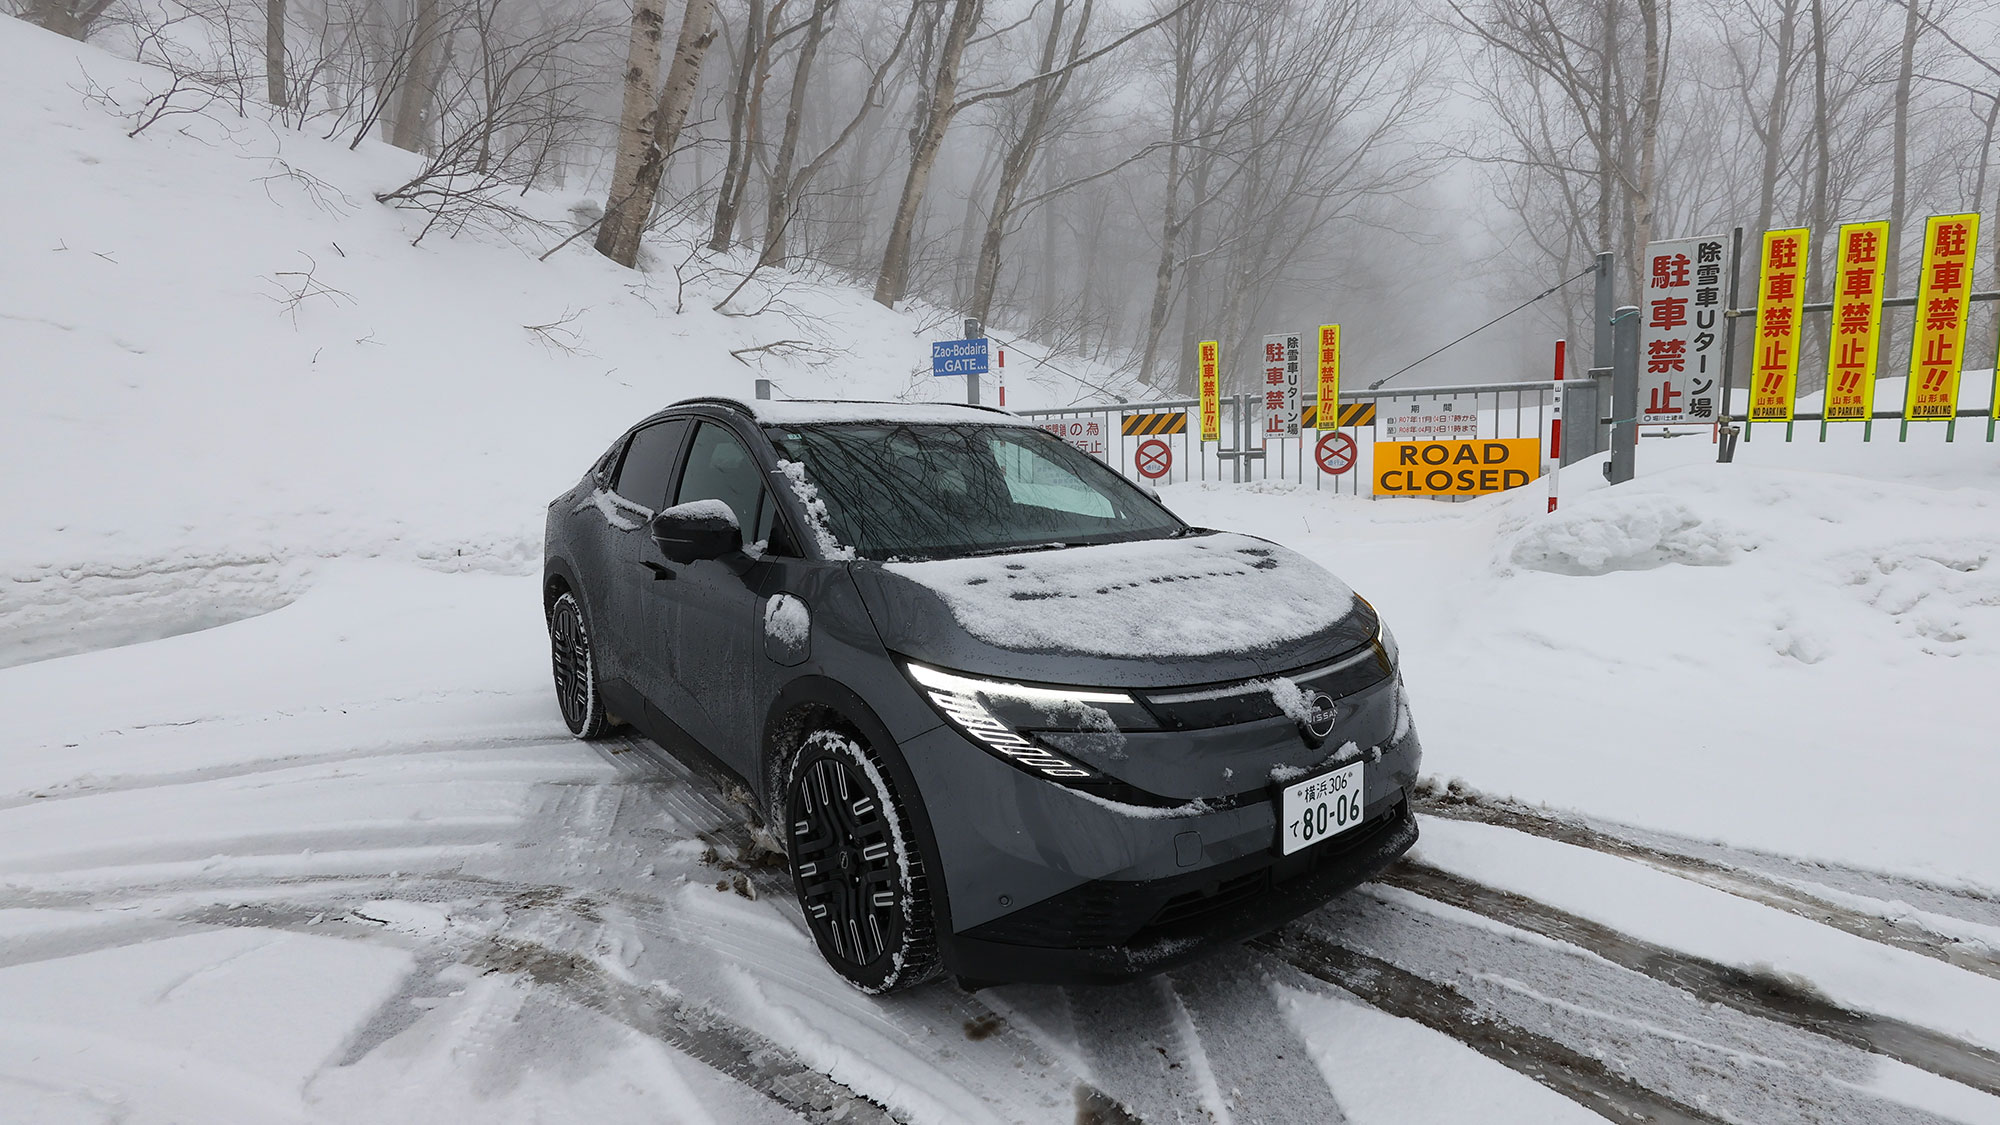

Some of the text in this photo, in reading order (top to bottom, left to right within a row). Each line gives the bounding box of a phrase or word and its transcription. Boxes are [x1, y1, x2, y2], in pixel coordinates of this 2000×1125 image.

[1644, 254, 1691, 414] 駐車禁止
[1689, 241, 1722, 418] 除雪車Uターン場
[934, 343, 987, 358] Zao-Bodaira
[944, 358, 977, 372] GATE
[1266, 343, 1285, 433] 駐車禁止
[1287, 337, 1299, 435] 除雪車Uターン場
[1757, 396, 1784, 405] 山形県
[1833, 396, 1861, 405] 山形県
[1918, 394, 1948, 403] 山形県
[1752, 407, 1787, 416] NO PARKING
[1828, 406, 1864, 416] NO PARKING
[1913, 405, 1951, 415] NO PARKING
[1400, 443, 1510, 466] ROAD
[1380, 469, 1530, 491] CLOSED
[1304, 772, 1348, 803] 横浜 306
[1290, 789, 1360, 841] て 80-06
